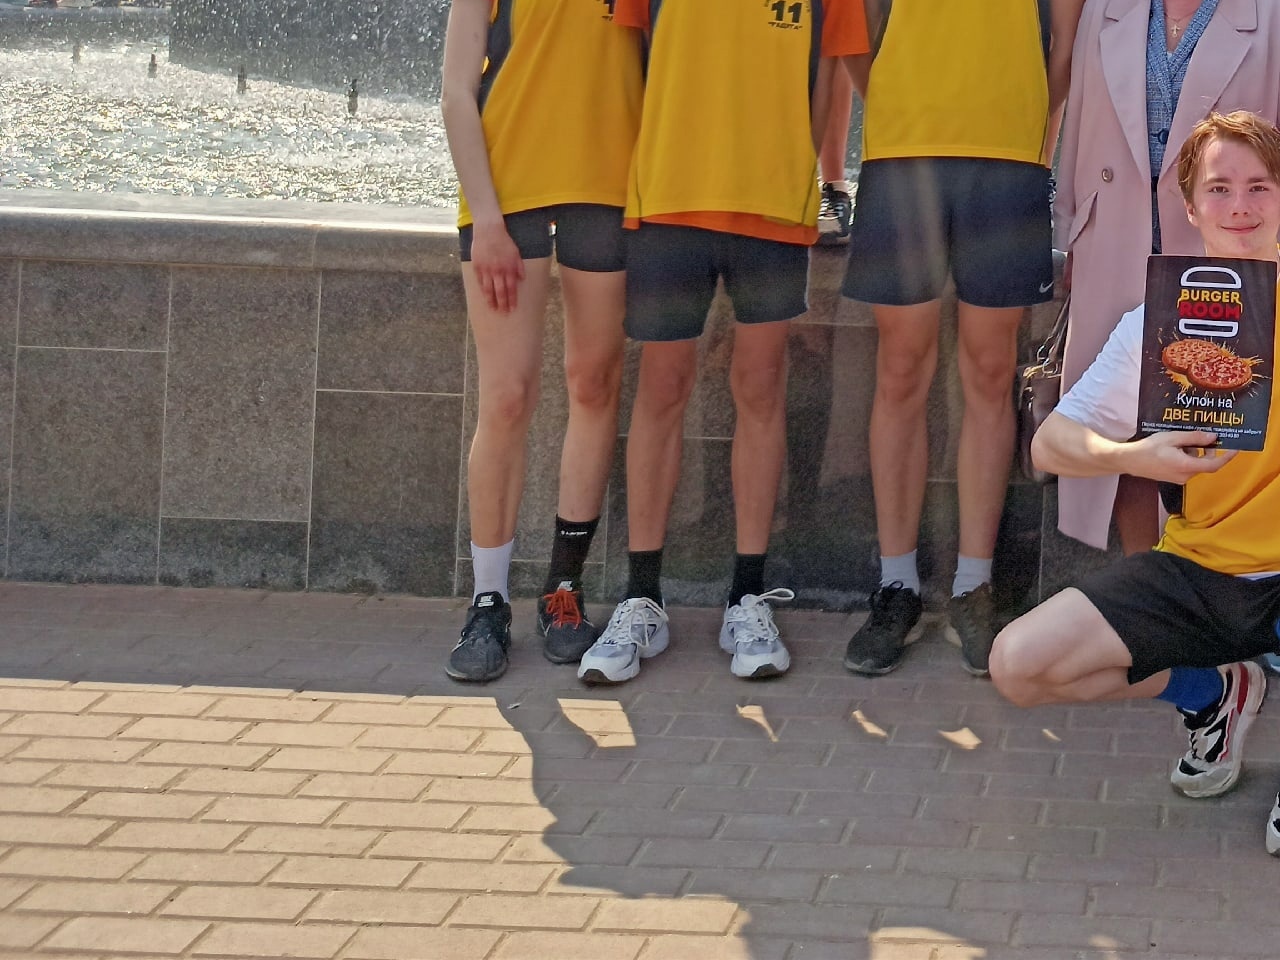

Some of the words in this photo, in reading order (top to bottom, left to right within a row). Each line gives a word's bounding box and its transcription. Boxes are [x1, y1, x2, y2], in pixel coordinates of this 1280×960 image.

[771, 0, 802, 23] 11
[1179, 289, 1242, 303] BURGER
[1178, 302, 1241, 320] ROOM
[1177, 393, 1214, 409] Купон
[1218, 398, 1233, 409] на
[1162, 407, 1190, 423] ДВЕ
[1193, 409, 1244, 426] ПИЦЦЫ
